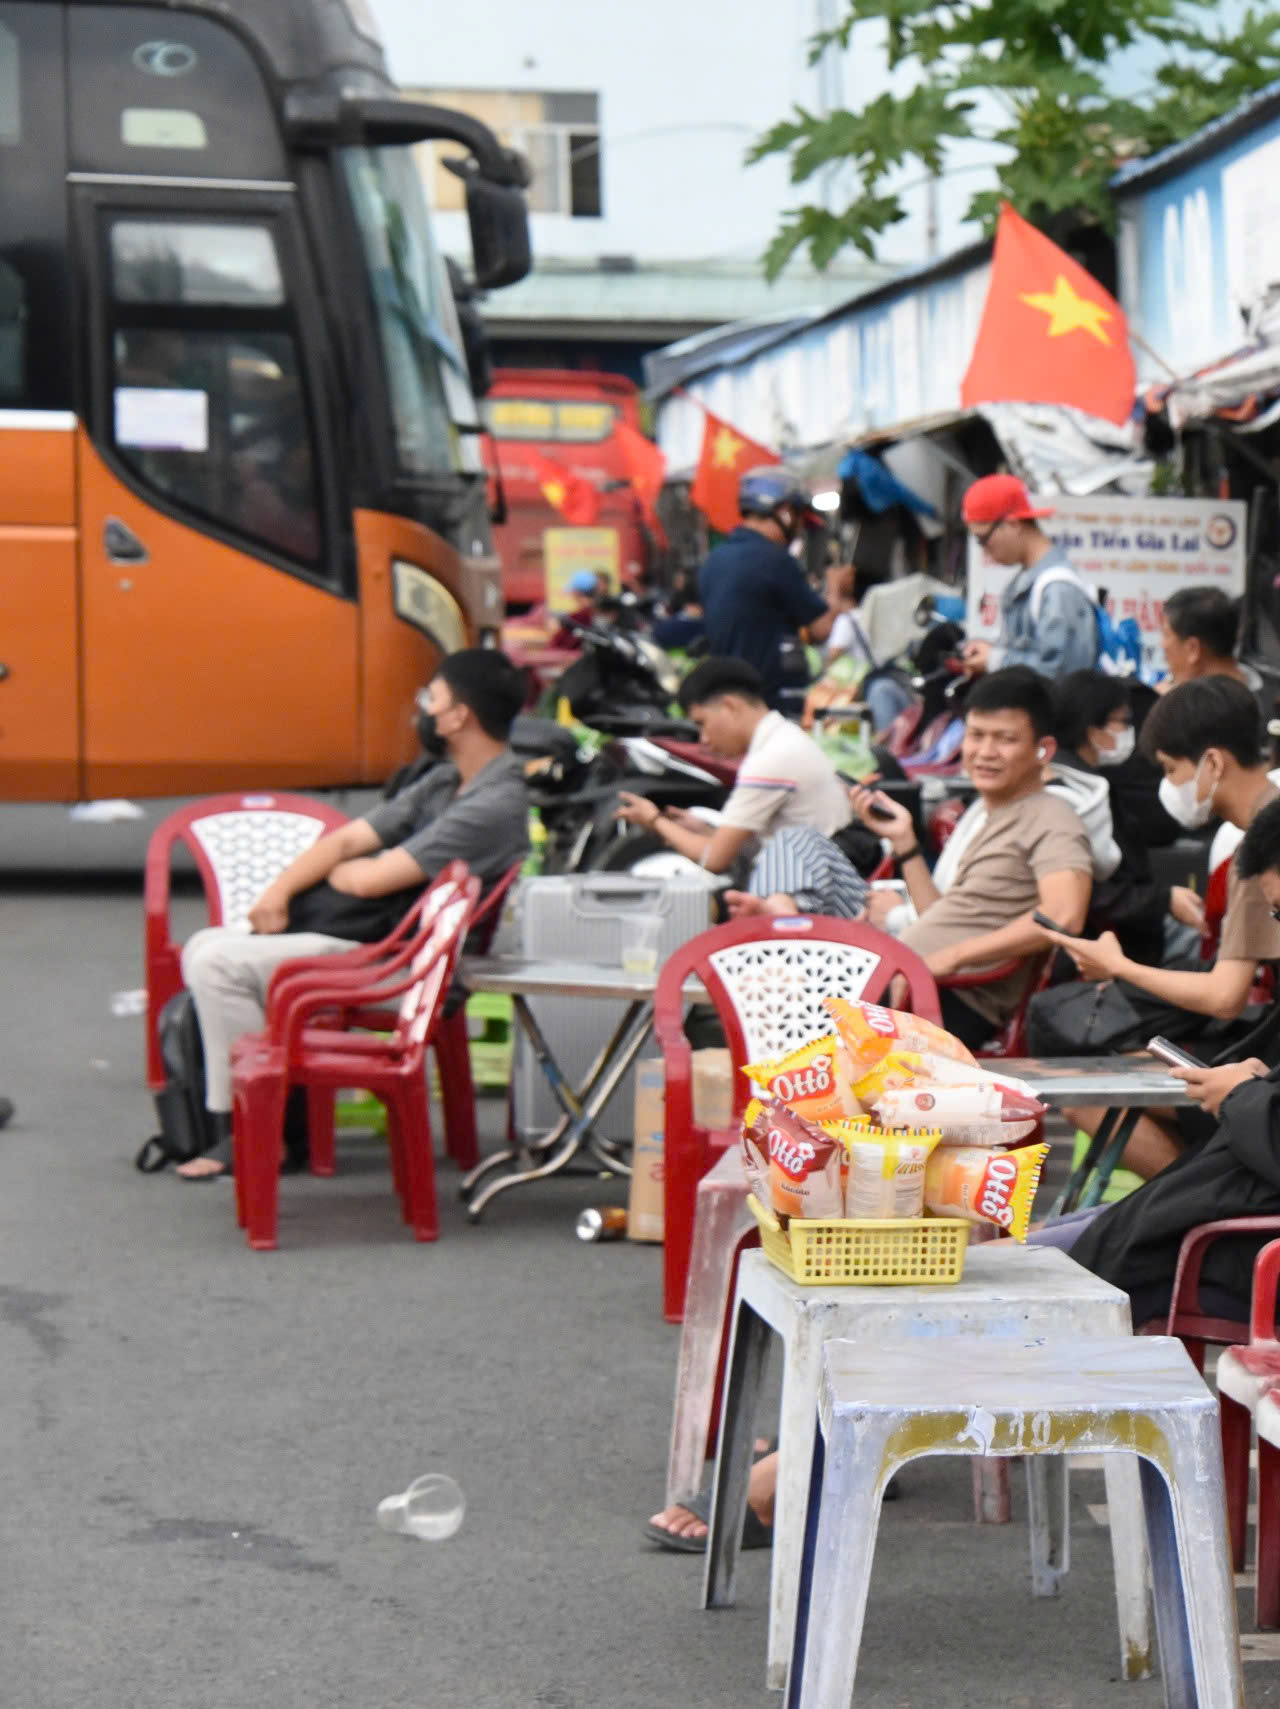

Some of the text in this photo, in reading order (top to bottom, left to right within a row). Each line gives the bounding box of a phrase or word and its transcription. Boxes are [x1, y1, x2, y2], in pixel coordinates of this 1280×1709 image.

[773, 1066, 830, 1102] Otto
[768, 1129, 804, 1174] Otto
[981, 1159, 1017, 1217] Otto
